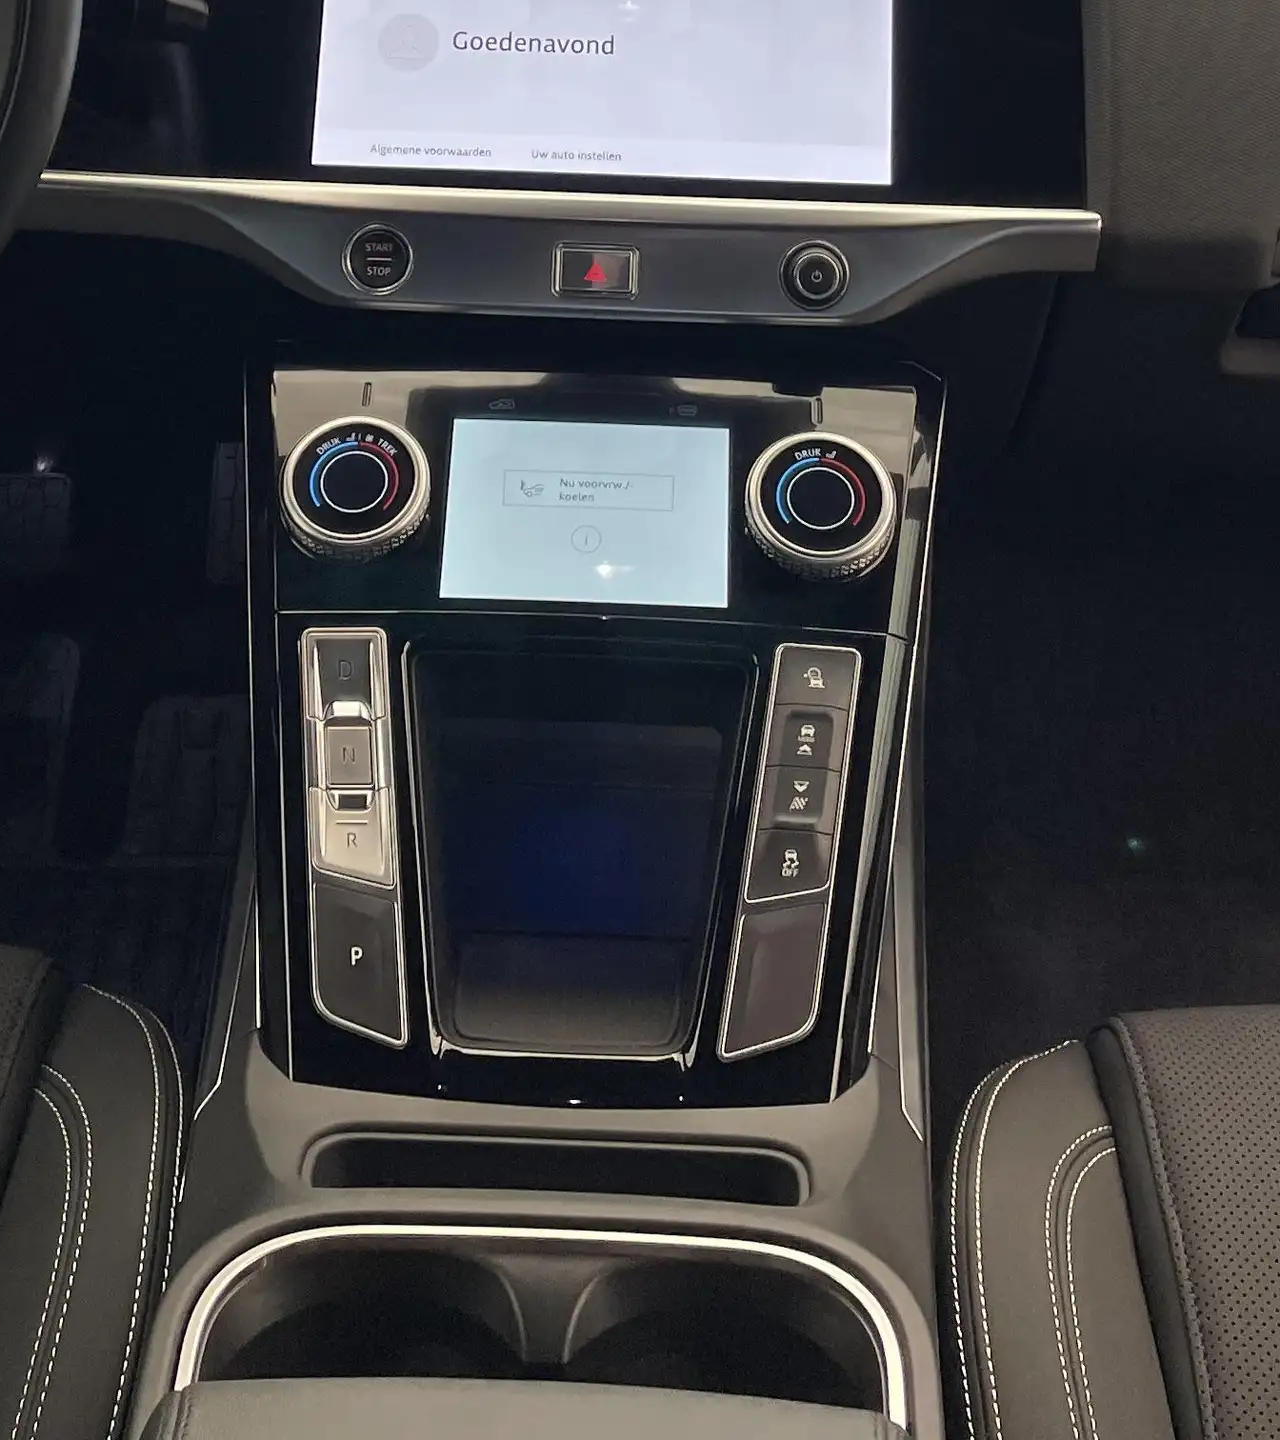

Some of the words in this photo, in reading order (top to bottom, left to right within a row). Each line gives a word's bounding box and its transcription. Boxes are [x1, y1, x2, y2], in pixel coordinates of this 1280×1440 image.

[452, 31, 615, 55] Goedenavond
[370, 144, 422, 156] Algemene
[423, 147, 492, 158] voorwaarden
[531, 149, 549, 160] Uw
[551, 151, 574, 160] auto
[577, 150, 622, 161] instellen
[365, 242, 393, 252] START
[366, 266, 392, 277] STOP
[794, 448, 822, 461] DRUK
[559, 478, 575, 488] Nu
[558, 491, 595, 502] koelen
[338, 659, 355, 680] D
[341, 746, 356, 766] N
[346, 832, 357, 848] R
[781, 868, 799, 878] OFF
[349, 946, 364, 966] P
